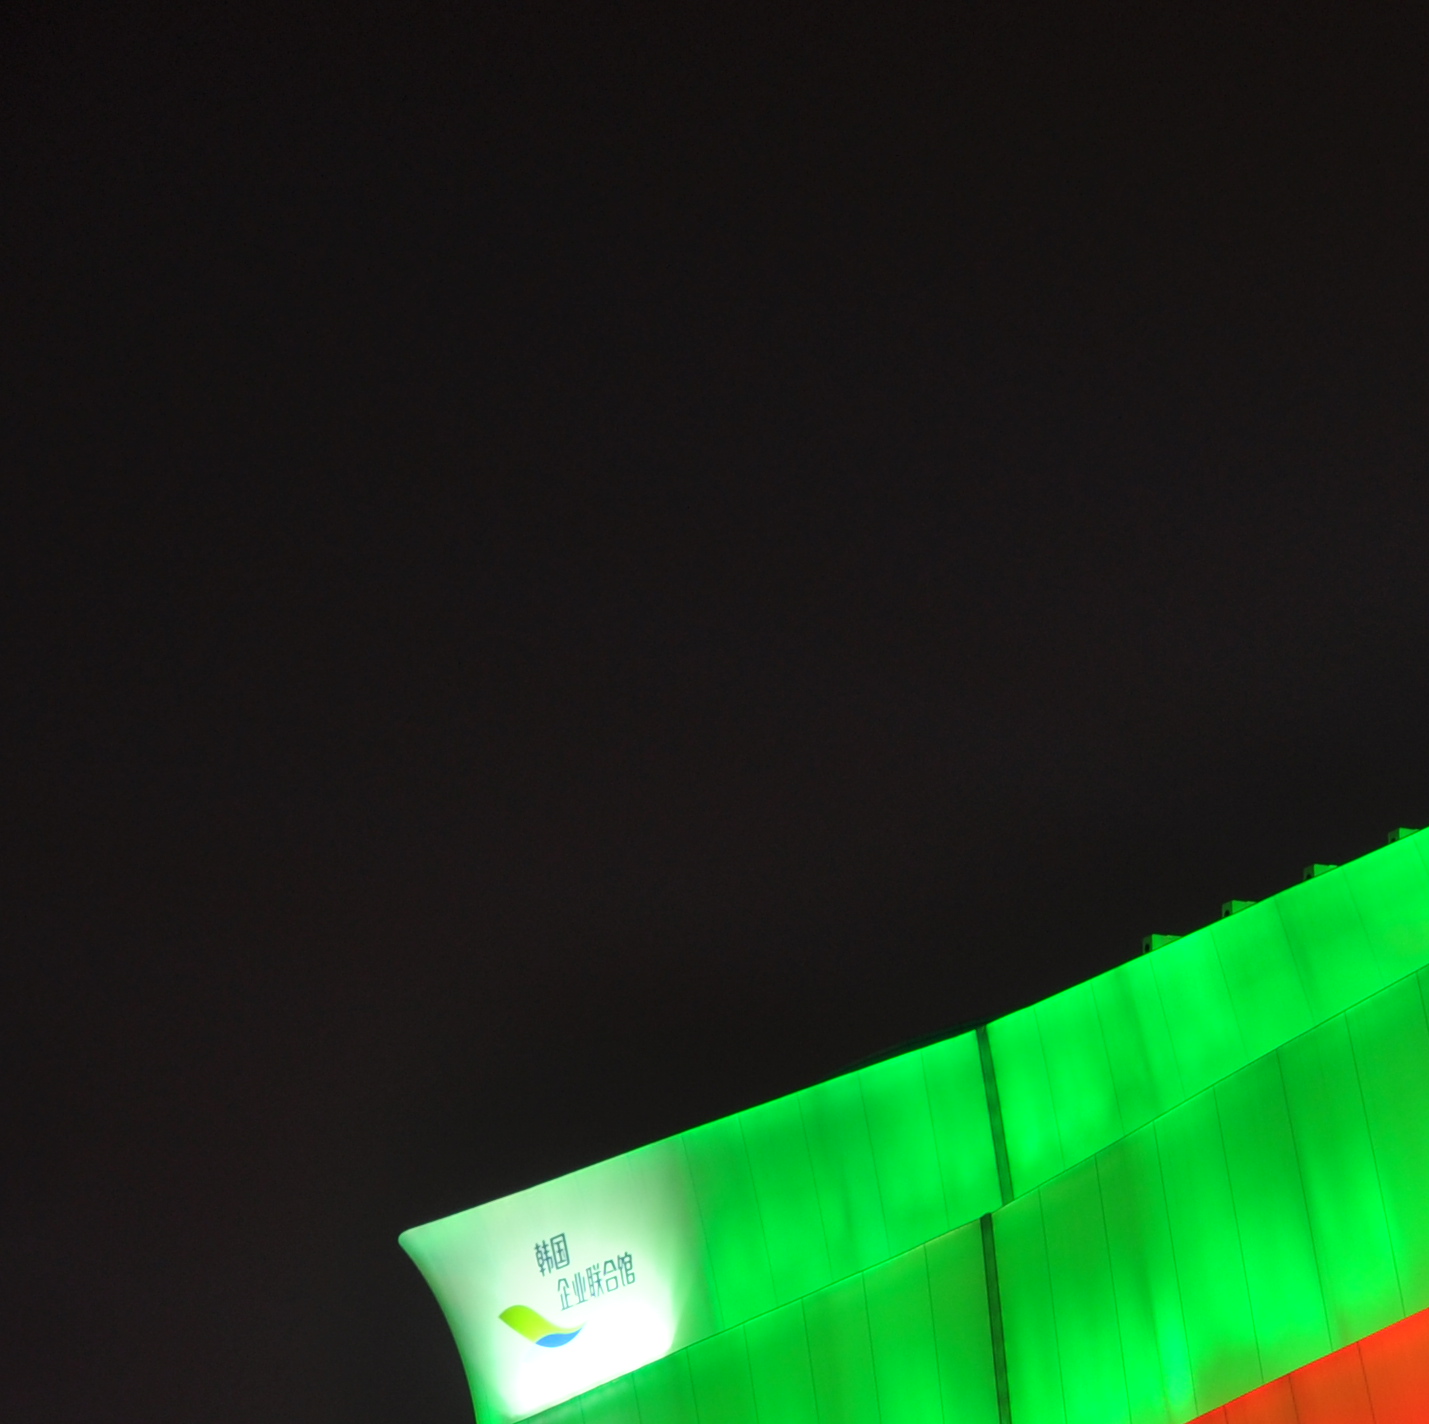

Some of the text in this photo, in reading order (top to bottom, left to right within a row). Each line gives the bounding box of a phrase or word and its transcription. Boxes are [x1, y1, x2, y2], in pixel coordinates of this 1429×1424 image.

[534, 1233, 570, 1276] 韩国
[557, 1252, 635, 1311] 企业联合馆
